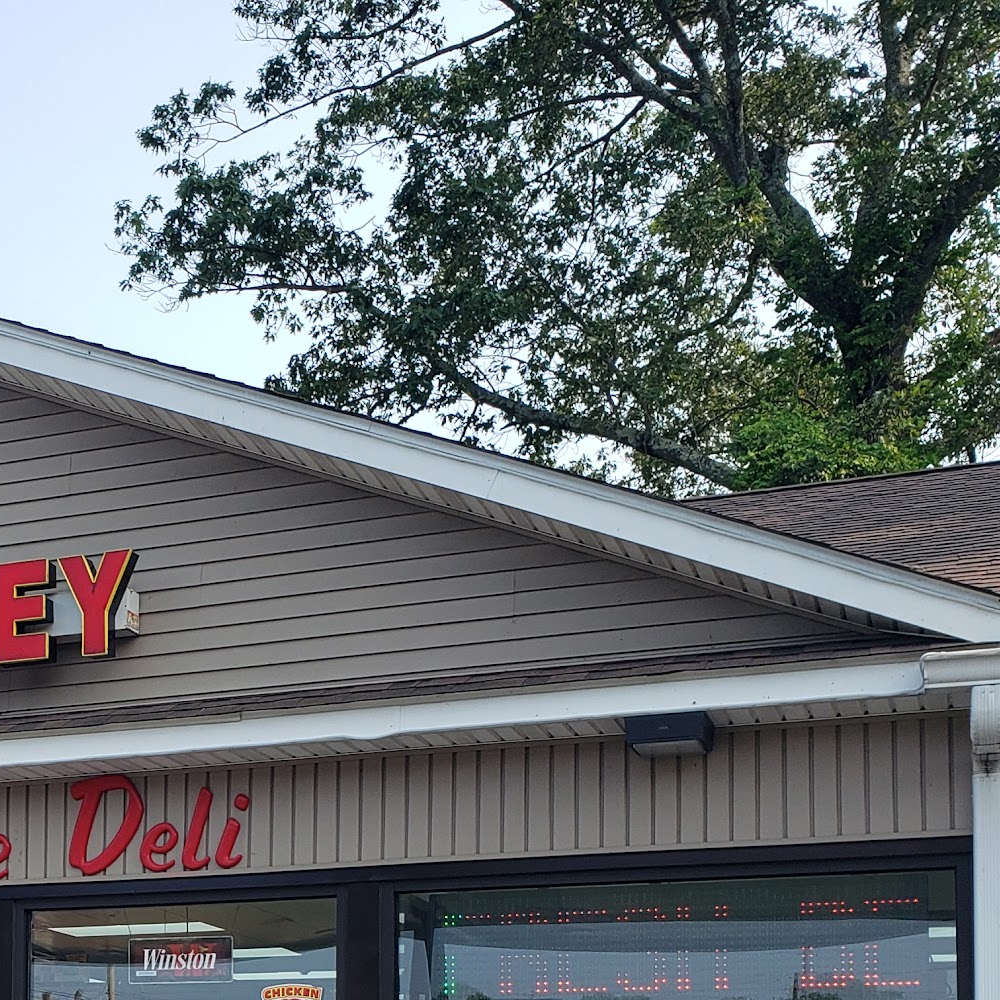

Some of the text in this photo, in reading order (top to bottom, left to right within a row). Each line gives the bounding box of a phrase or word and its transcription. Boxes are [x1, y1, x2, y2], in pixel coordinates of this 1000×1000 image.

[69, 774, 250, 877] Deli
[143, 948, 217, 971] Winston
[264, 987, 319, 999] CHICKEN
